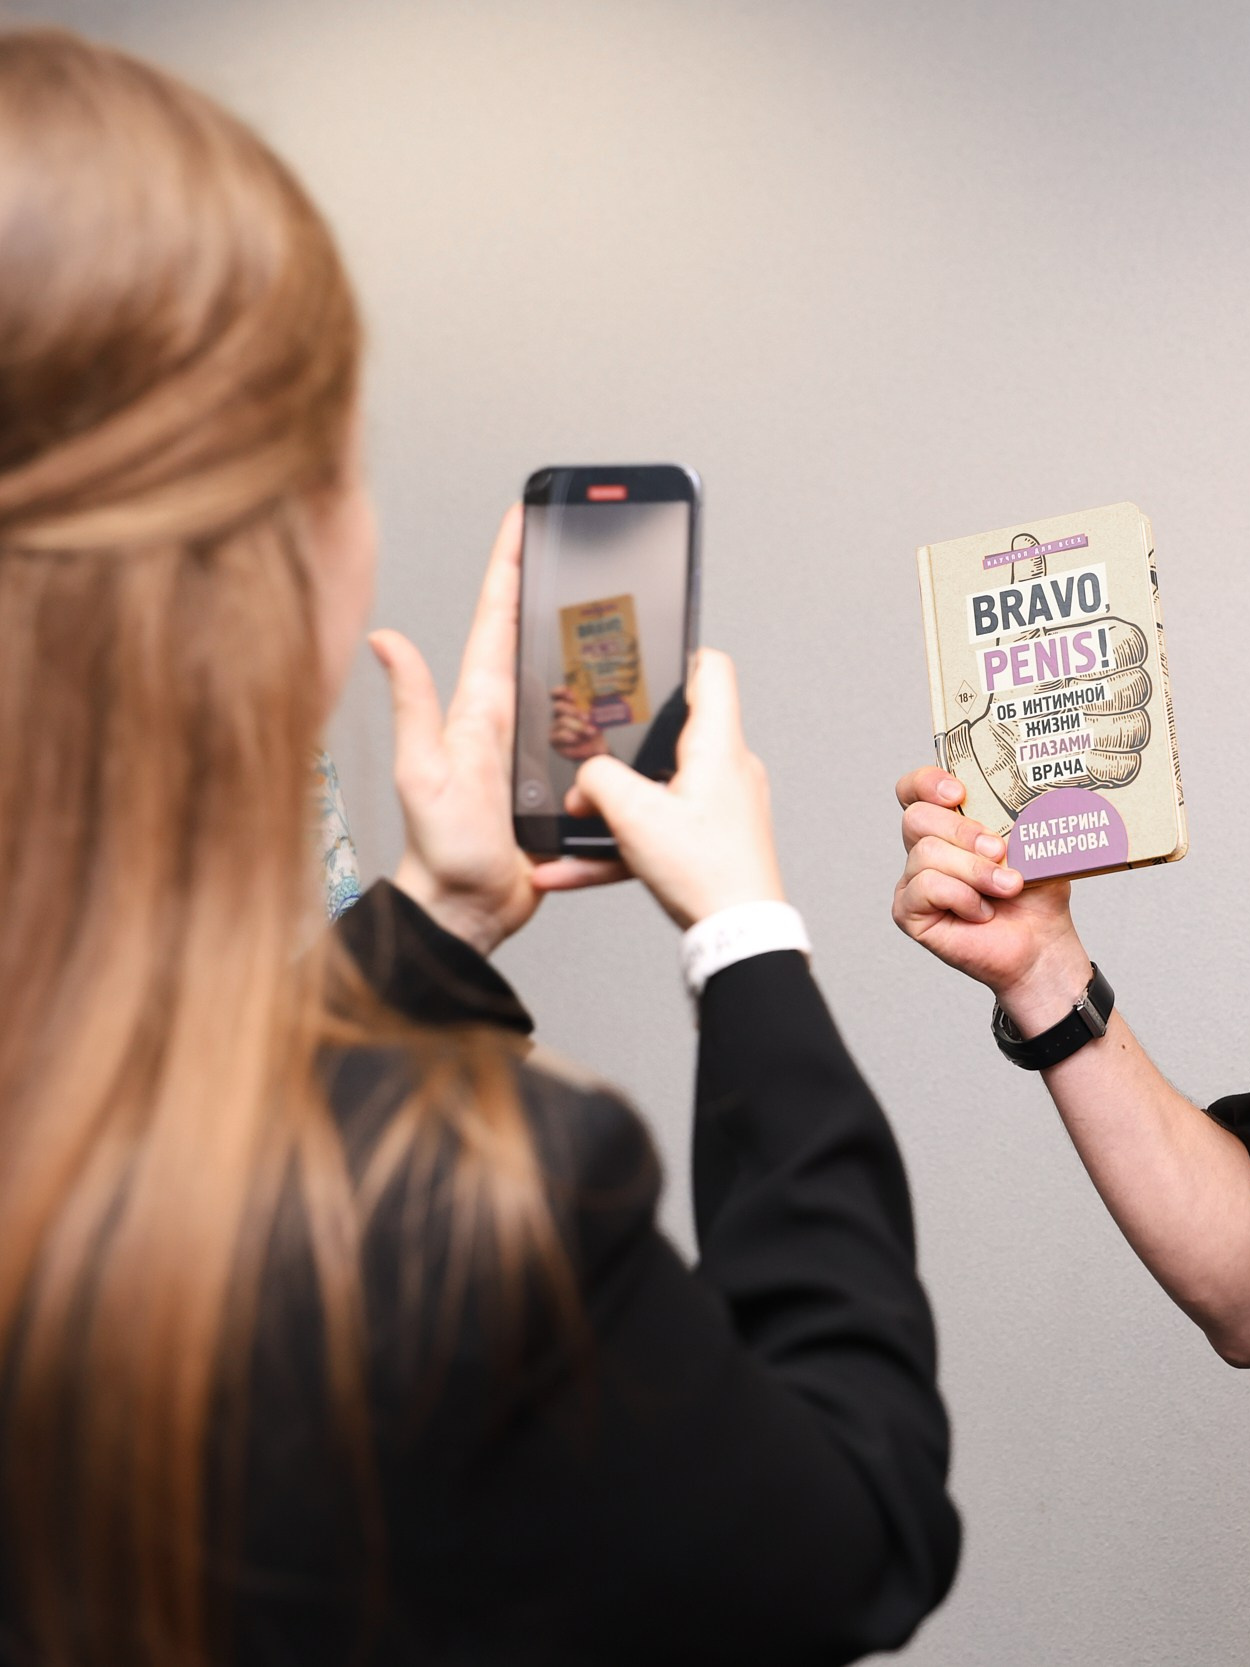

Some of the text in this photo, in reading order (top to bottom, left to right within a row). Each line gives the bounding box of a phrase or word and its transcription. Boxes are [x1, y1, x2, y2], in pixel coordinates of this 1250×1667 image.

[987, 537, 1082, 567] НАУЧПОП ДЛЯ ВСЕХ
[972, 572, 1110, 636] BRAVO,
[983, 630, 1110, 692] PENIS!
[958, 692, 975, 704] 18+
[996, 683, 1106, 721] ОБ ИНТИМНОЙ
[1025, 713, 1081, 738] ЖИЗНИ
[1020, 734, 1092, 762] ГЛАЗАМИ
[1031, 758, 1084, 782] ВРАЧА
[1019, 809, 1110, 842] ЕКАТЕРИНА
[1024, 837, 1110, 861] МАКАРОВА
